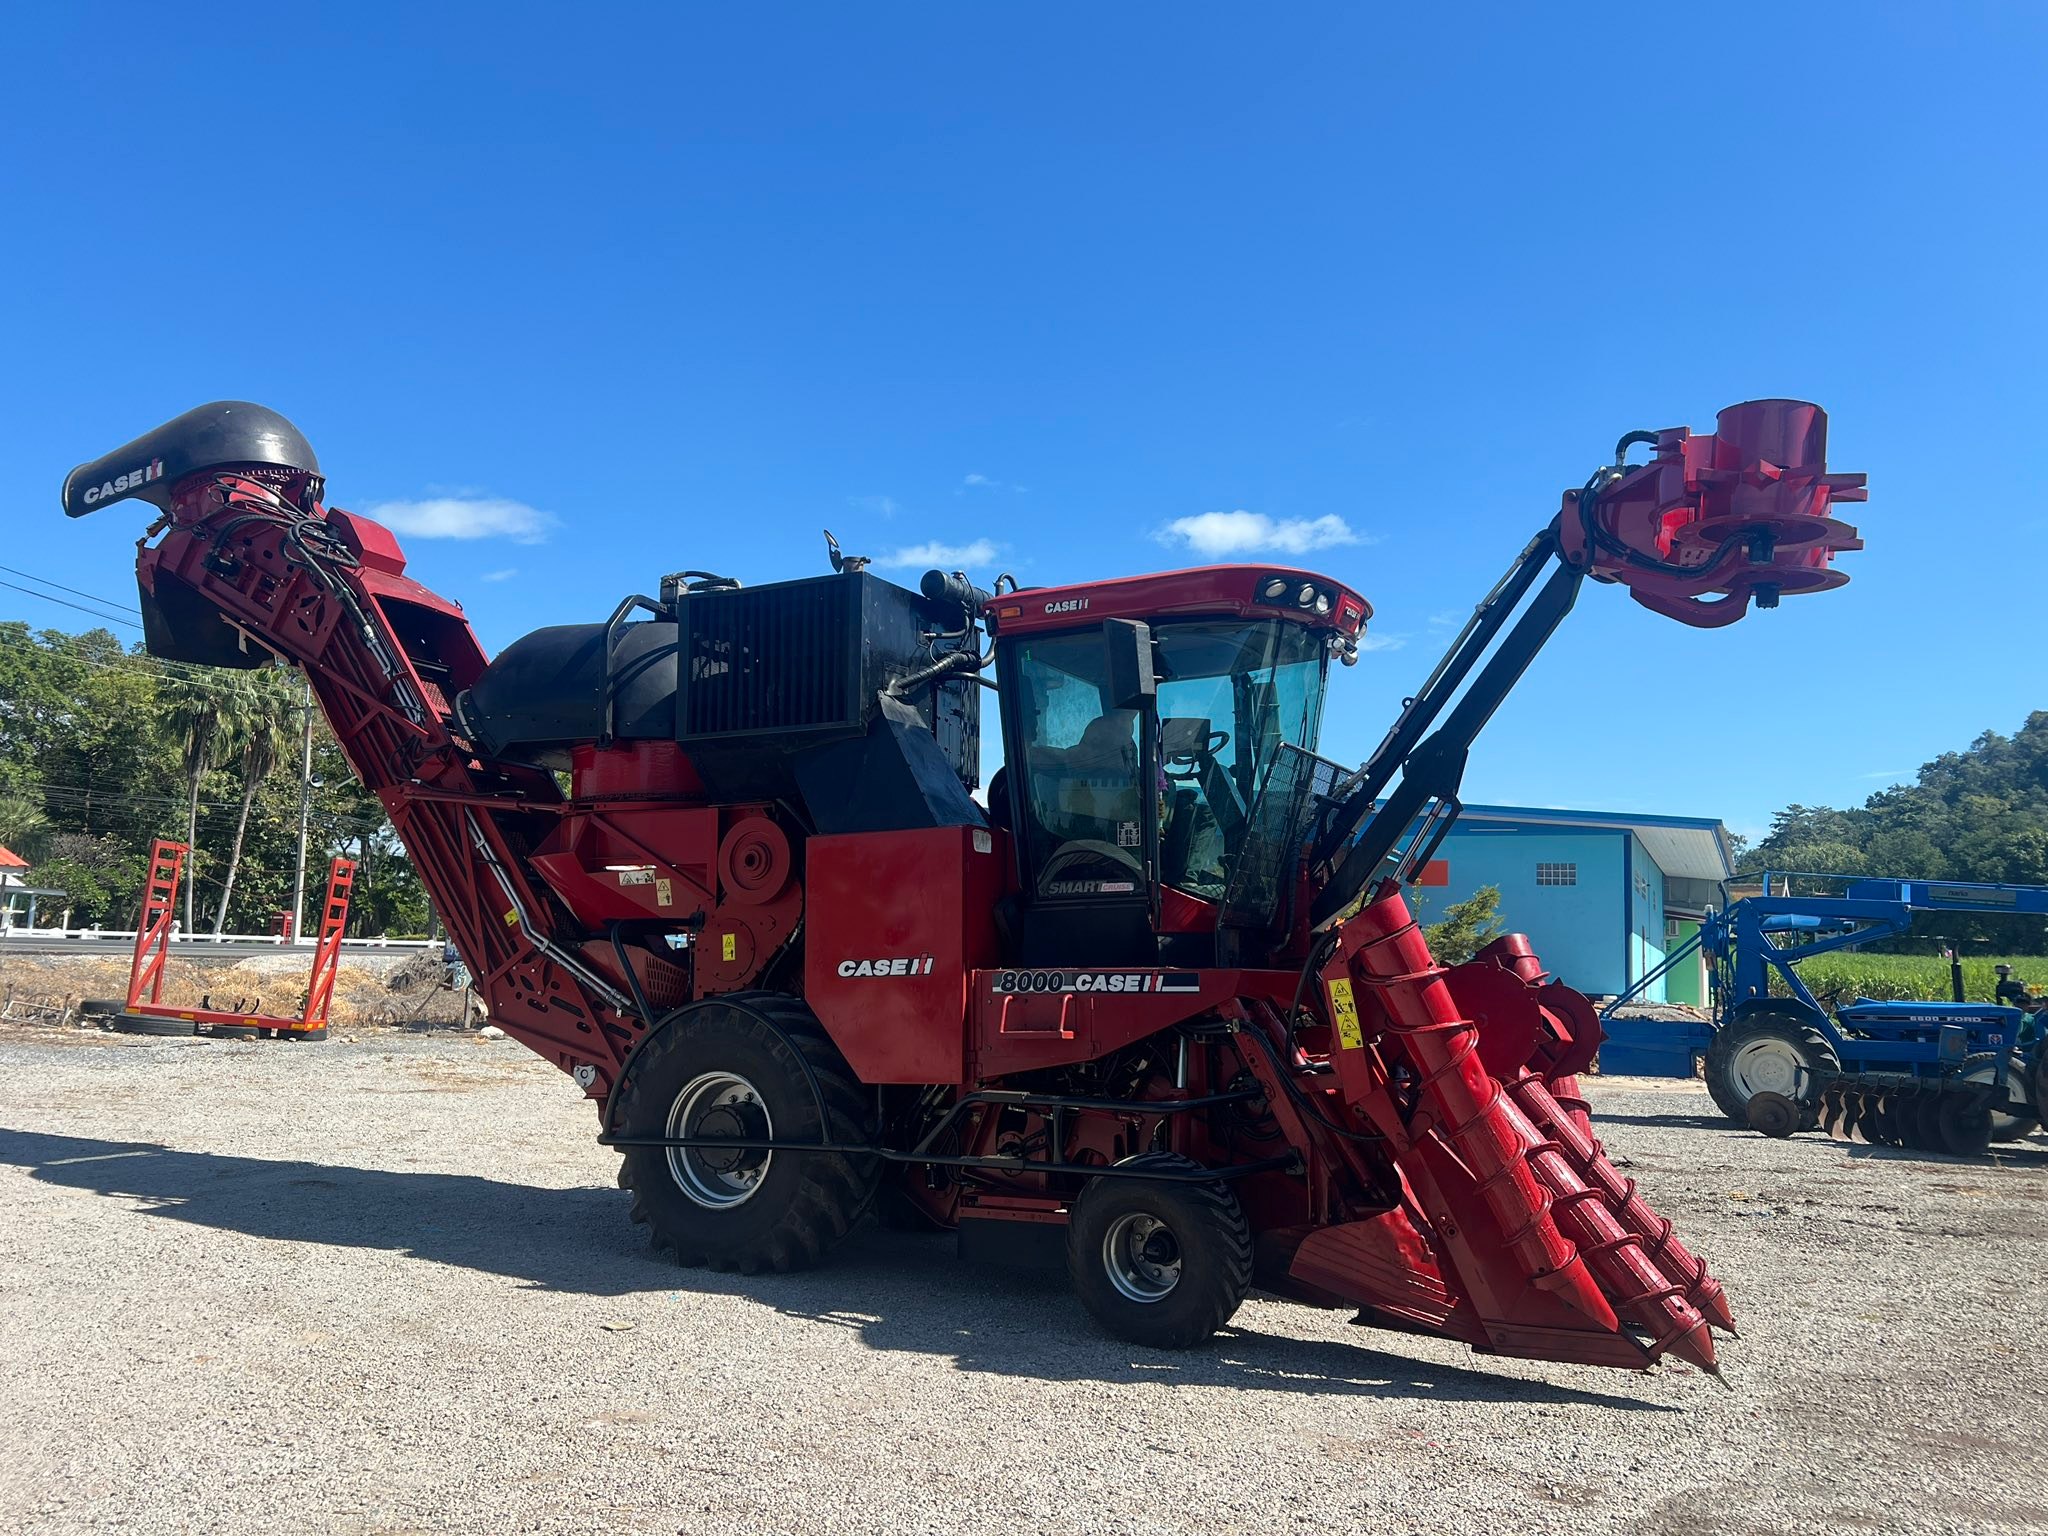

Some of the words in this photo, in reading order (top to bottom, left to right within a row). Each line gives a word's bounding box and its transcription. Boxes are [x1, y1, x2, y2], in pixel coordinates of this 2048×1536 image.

[83, 470, 144, 504] CASE
[1044, 599, 1078, 614] CASE
[1047, 880, 1106, 895] SMART
[837, 959, 909, 977] CASE
[1000, 970, 1065, 993] 8000
[1075, 974, 1142, 992] CASE
